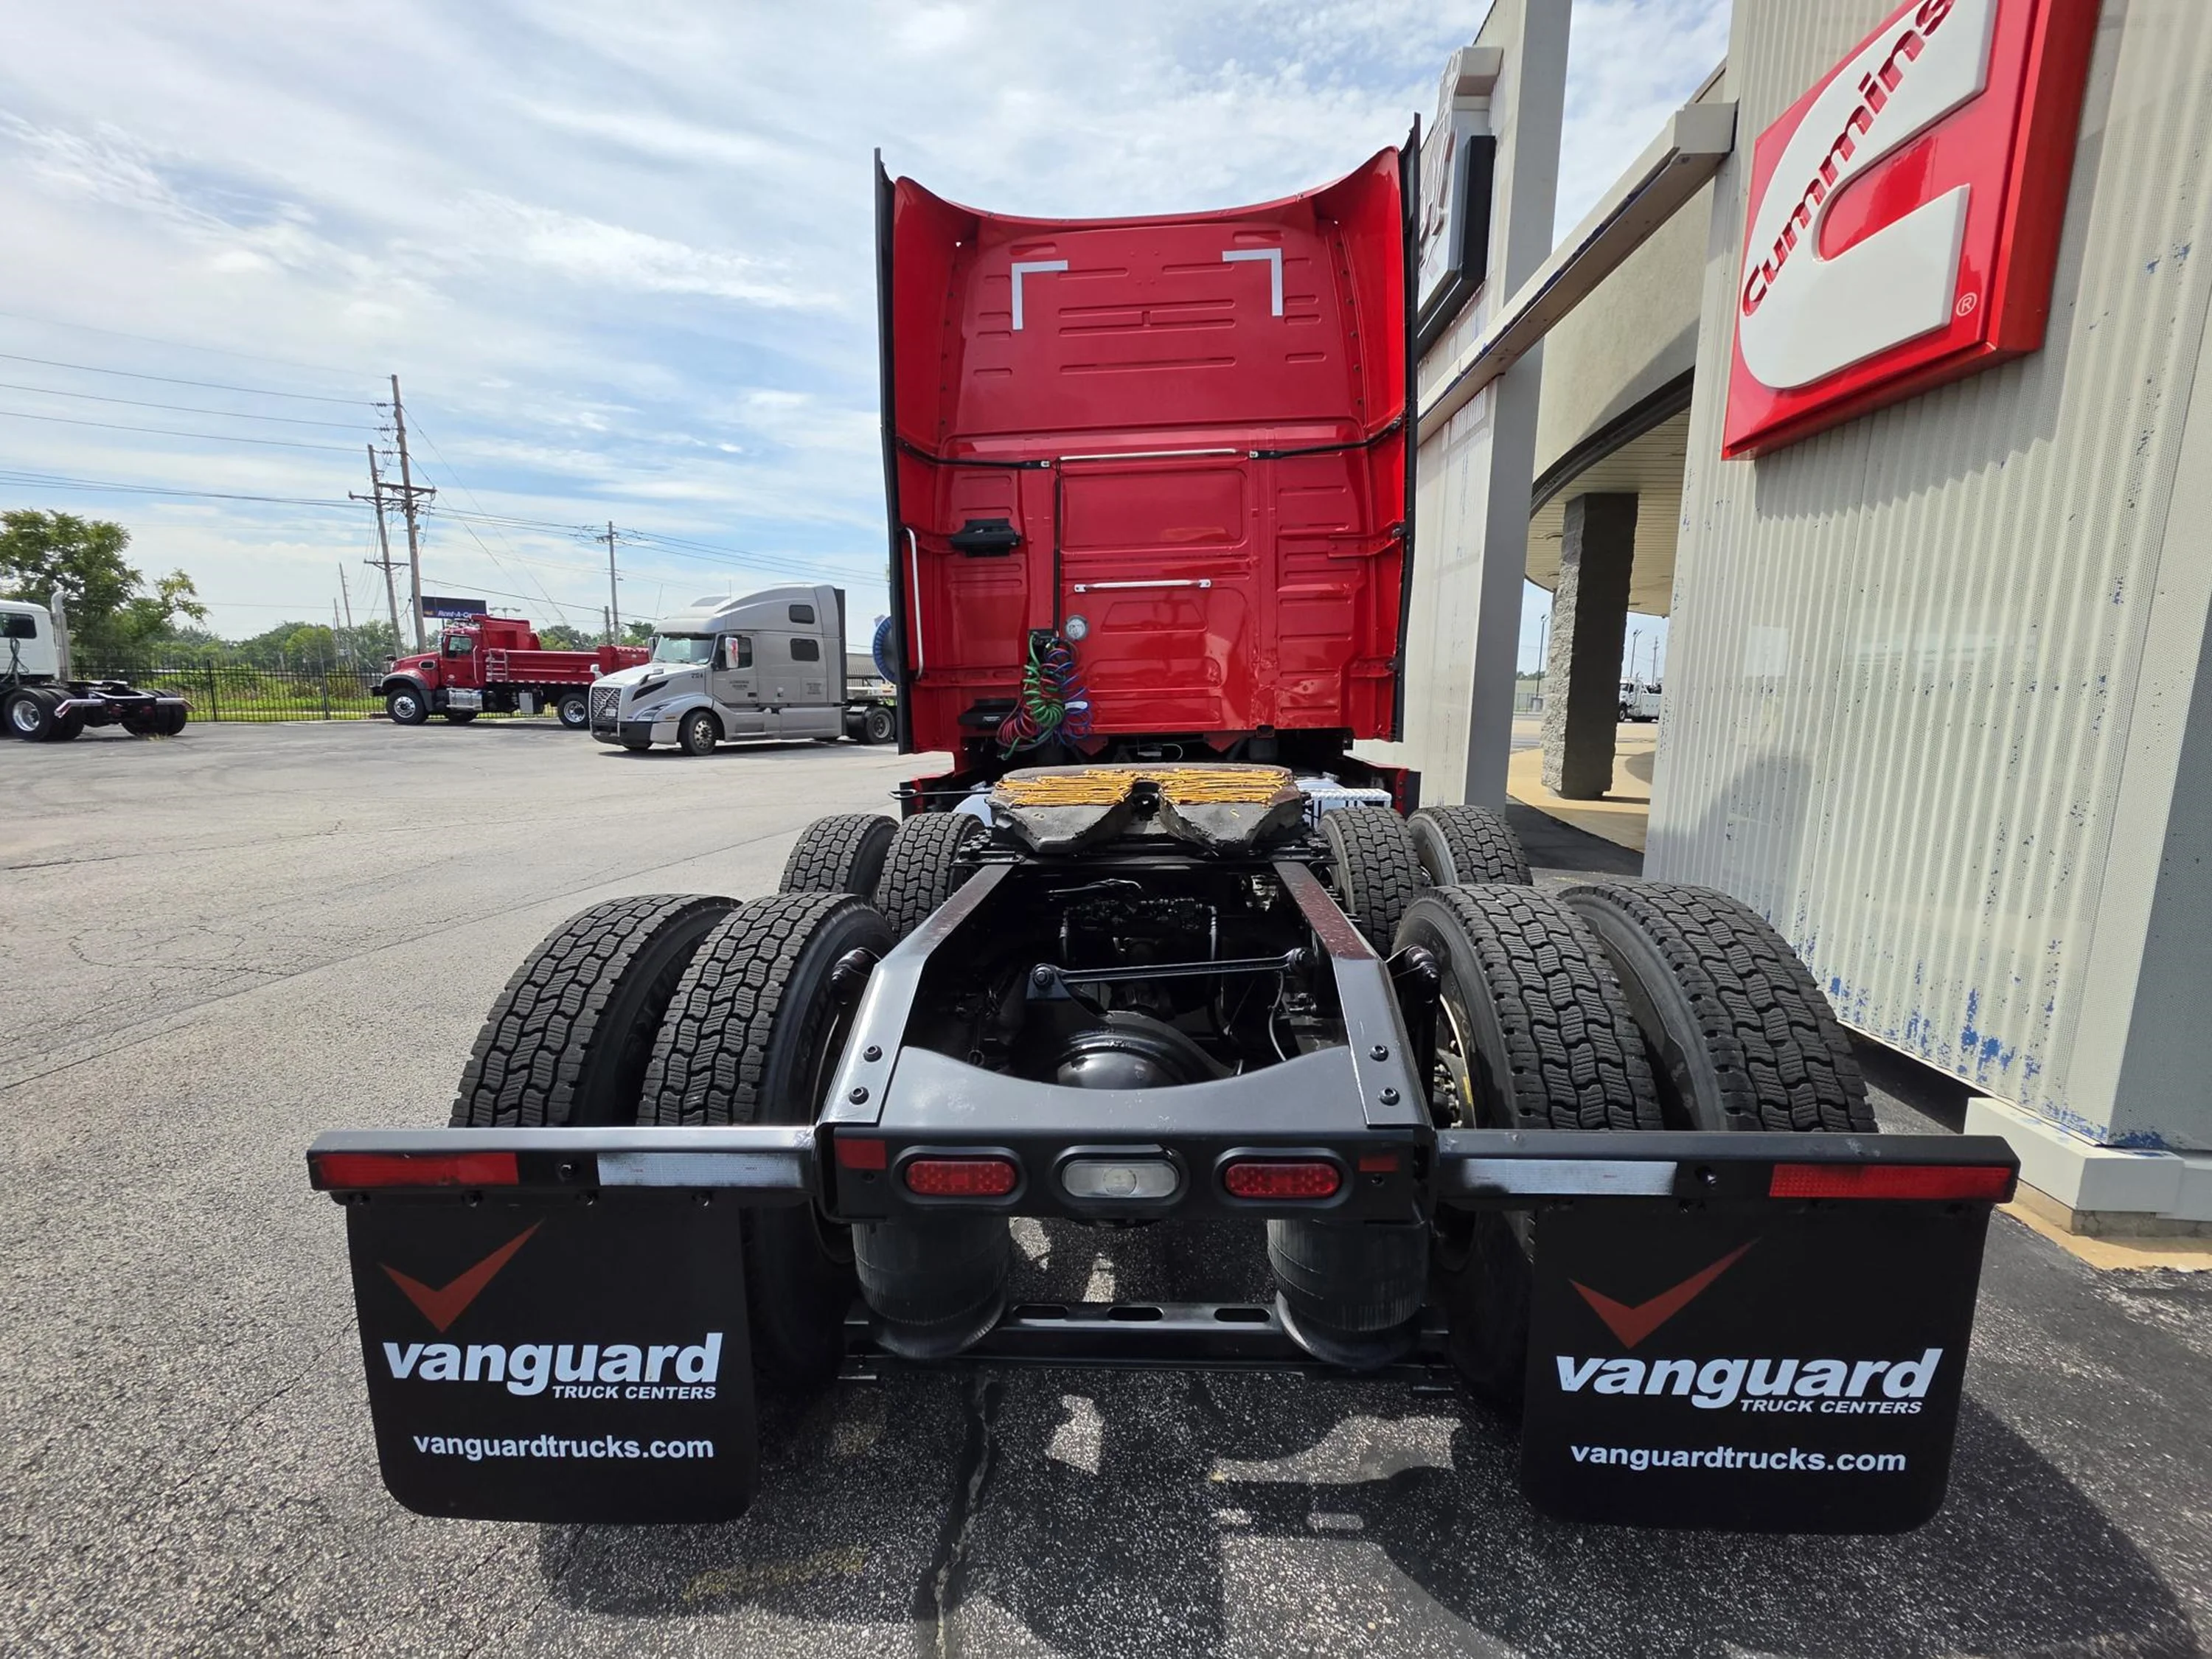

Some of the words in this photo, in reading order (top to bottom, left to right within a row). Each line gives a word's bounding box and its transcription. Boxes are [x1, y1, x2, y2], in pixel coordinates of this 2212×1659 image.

[1743, 0, 1955, 317] Cummins
[383, 1332, 723, 1396] vanguard
[552, 1385, 619, 1399] TRUCK
[625, 1386, 717, 1399] CENTERS
[1557, 1348, 1943, 1409] vanguard
[1740, 1399, 1815, 1413] TRUCK
[1820, 1400, 1923, 1414] CENTERS
[413, 1434, 714, 1461] vanguardtrucks.com
[1571, 1445, 1906, 1471] vanguardtrucks.com
